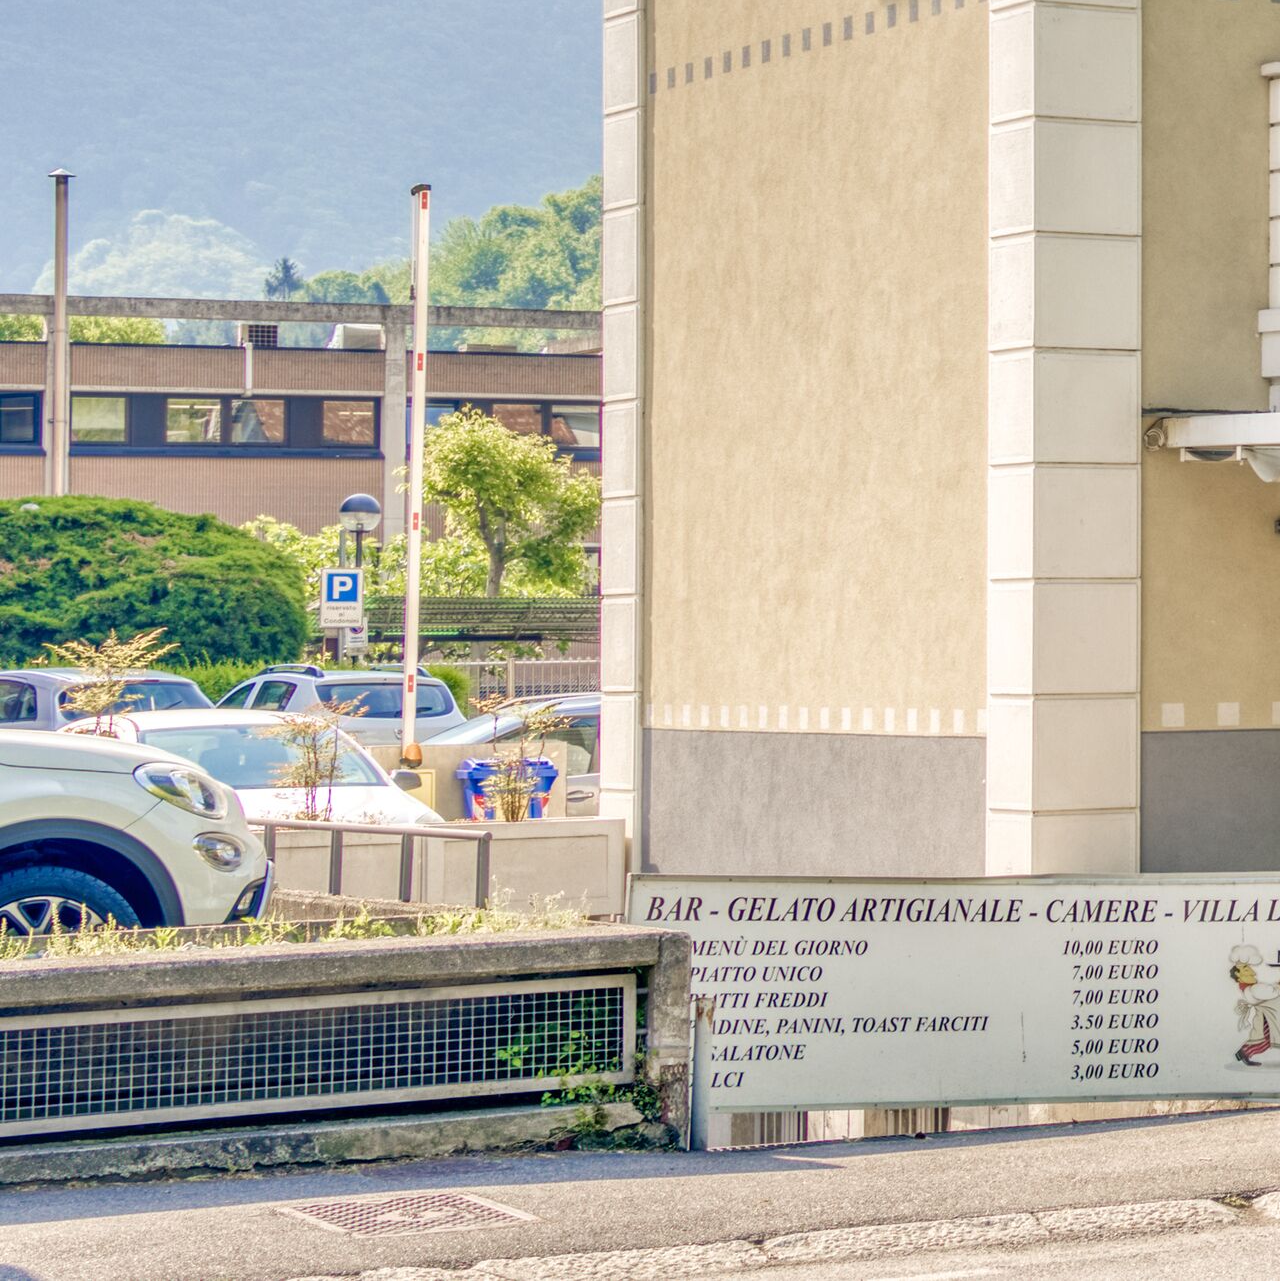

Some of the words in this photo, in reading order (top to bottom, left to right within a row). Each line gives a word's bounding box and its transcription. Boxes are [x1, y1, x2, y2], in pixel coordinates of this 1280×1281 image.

[333, 576, 353, 599] P
[646, 896, 703, 921] BAR
[727, 896, 836, 923] GELATO
[840, 897, 1023, 924] ARTIGIANALE
[1046, 898, 1158, 925] CAMERE
[1180, 898, 1262, 924] VILLA
[691, 936, 748, 956] MENÙ
[752, 940, 789, 956] DEL
[794, 940, 868, 956] GIORNO
[1063, 940, 1103, 957] 10,00
[1108, 940, 1159, 955] EURO
[690, 966, 757, 982] PIATTO
[762, 966, 823, 982] UNICO
[1072, 965, 1103, 982] 7,00
[1108, 964, 1159, 979] EURO
[754, 992, 829, 1007] FREDDI
[1072, 990, 1103, 1007] 7,00
[1108, 989, 1159, 1004] EURO
[776, 1018, 845, 1036] PANINI,
[853, 1017, 911, 1033] TOAST
[915, 1015, 989, 1034] FARCITI
[1071, 1015, 1103, 1030] 3.50
[1107, 1014, 1159, 1029] EURO
[1072, 1039, 1103, 1056] 5,00
[1108, 1038, 1159, 1054] EURO
[1071, 1064, 1103, 1081] 3,00
[1108, 1063, 1159, 1078] EURO
